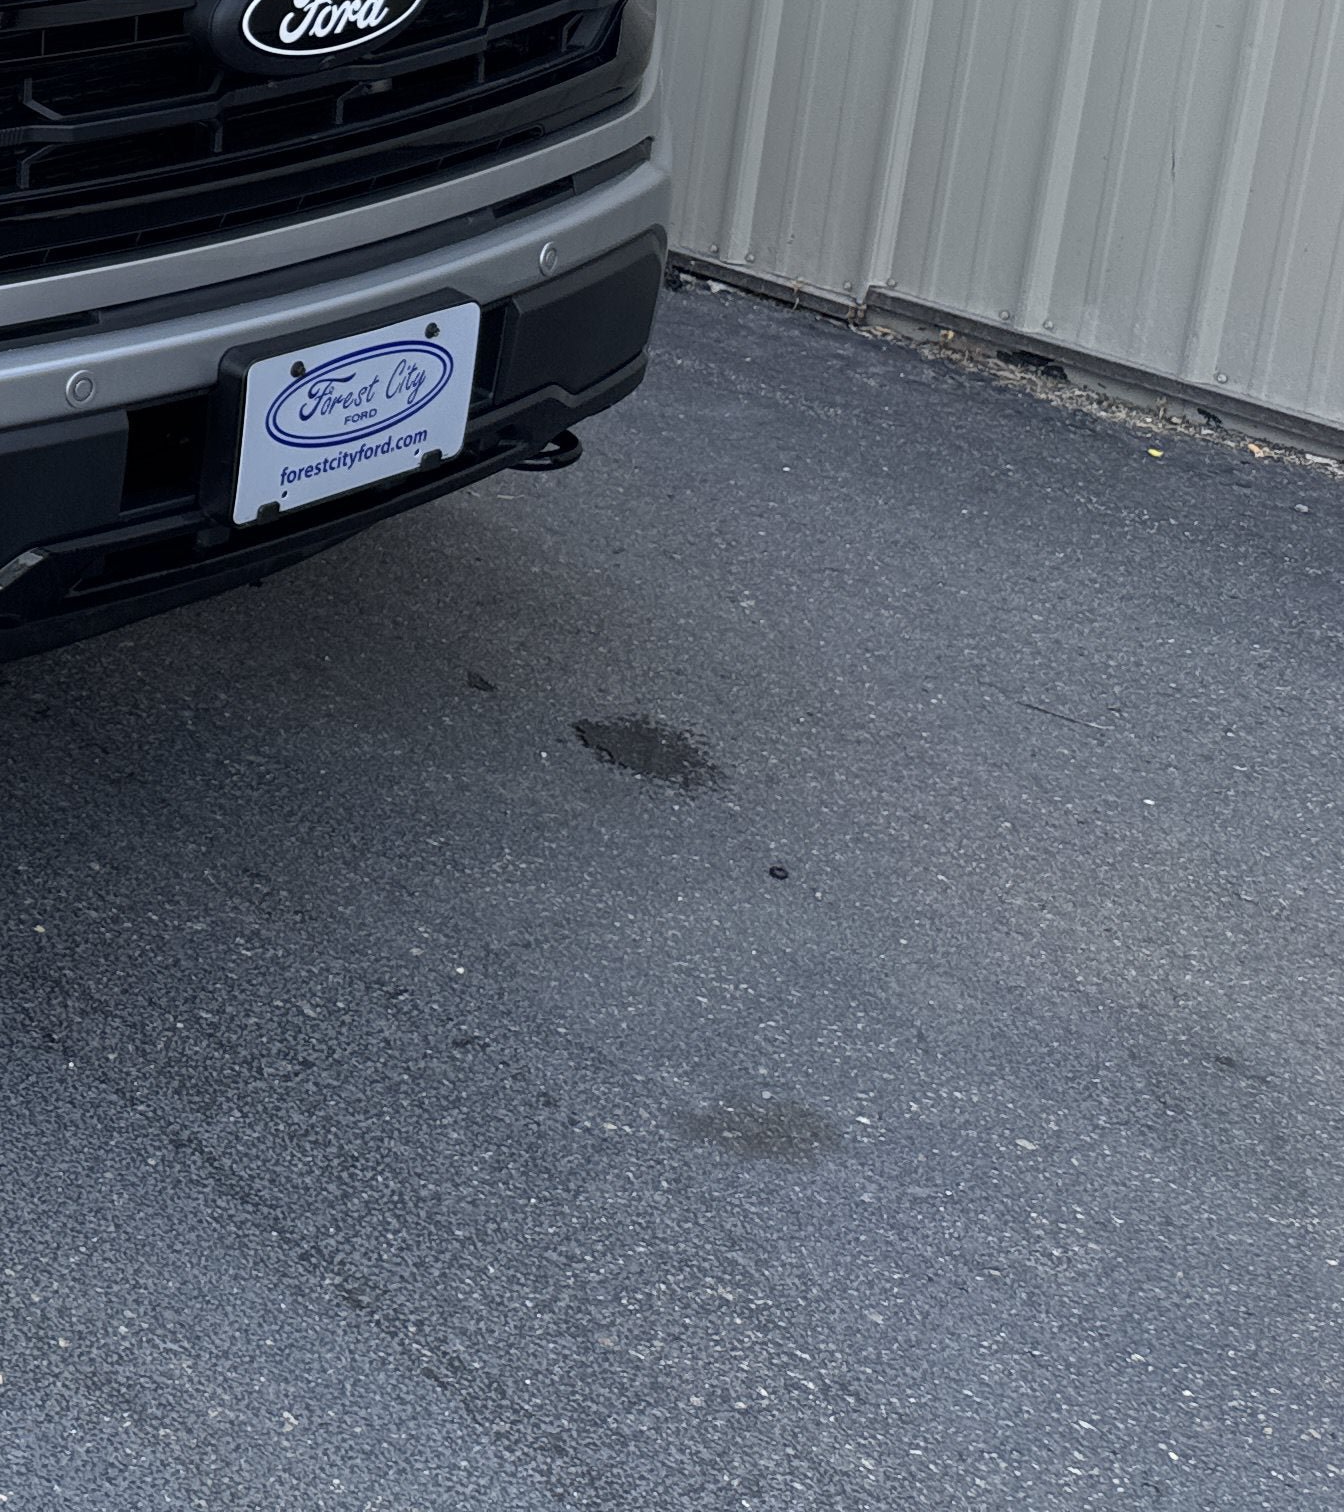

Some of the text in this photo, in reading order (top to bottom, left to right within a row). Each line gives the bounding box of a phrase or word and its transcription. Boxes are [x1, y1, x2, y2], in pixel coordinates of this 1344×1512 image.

[299, 359, 427, 421] Forest City
[344, 408, 378, 425] FORD
[280, 429, 428, 486] forestcityford.com
